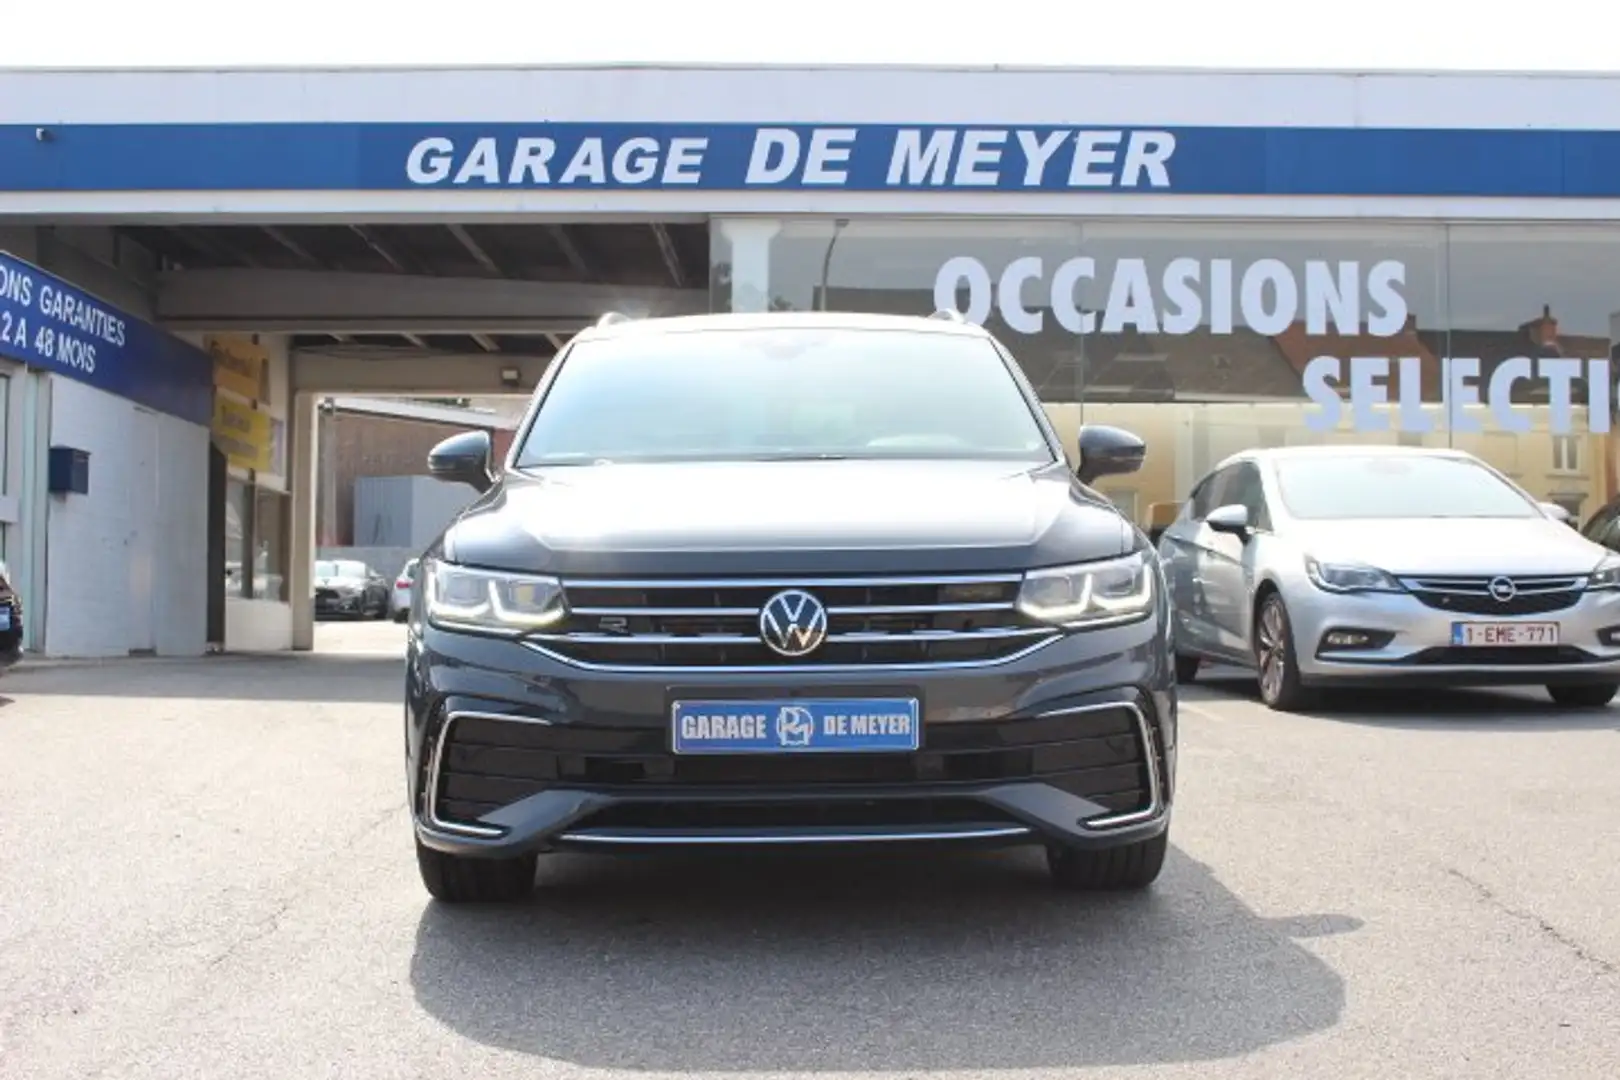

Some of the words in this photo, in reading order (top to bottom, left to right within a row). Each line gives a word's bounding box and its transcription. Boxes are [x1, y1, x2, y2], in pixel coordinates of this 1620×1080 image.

[405, 136, 709, 185] GARAGE
[744, 128, 858, 185] DE
[886, 129, 1177, 188] MEYER
[40, 285, 126, 348] GARANTIES
[933, 256, 1408, 336] OCCASIONS
[34, 326, 55, 357] 48
[56, 332, 96, 374] MOIS
[1302, 355, 1620, 433] SELECTI
[681, 715, 767, 740] GARAGE
[823, 714, 848, 736] DE
[851, 714, 911, 736] MEYER
